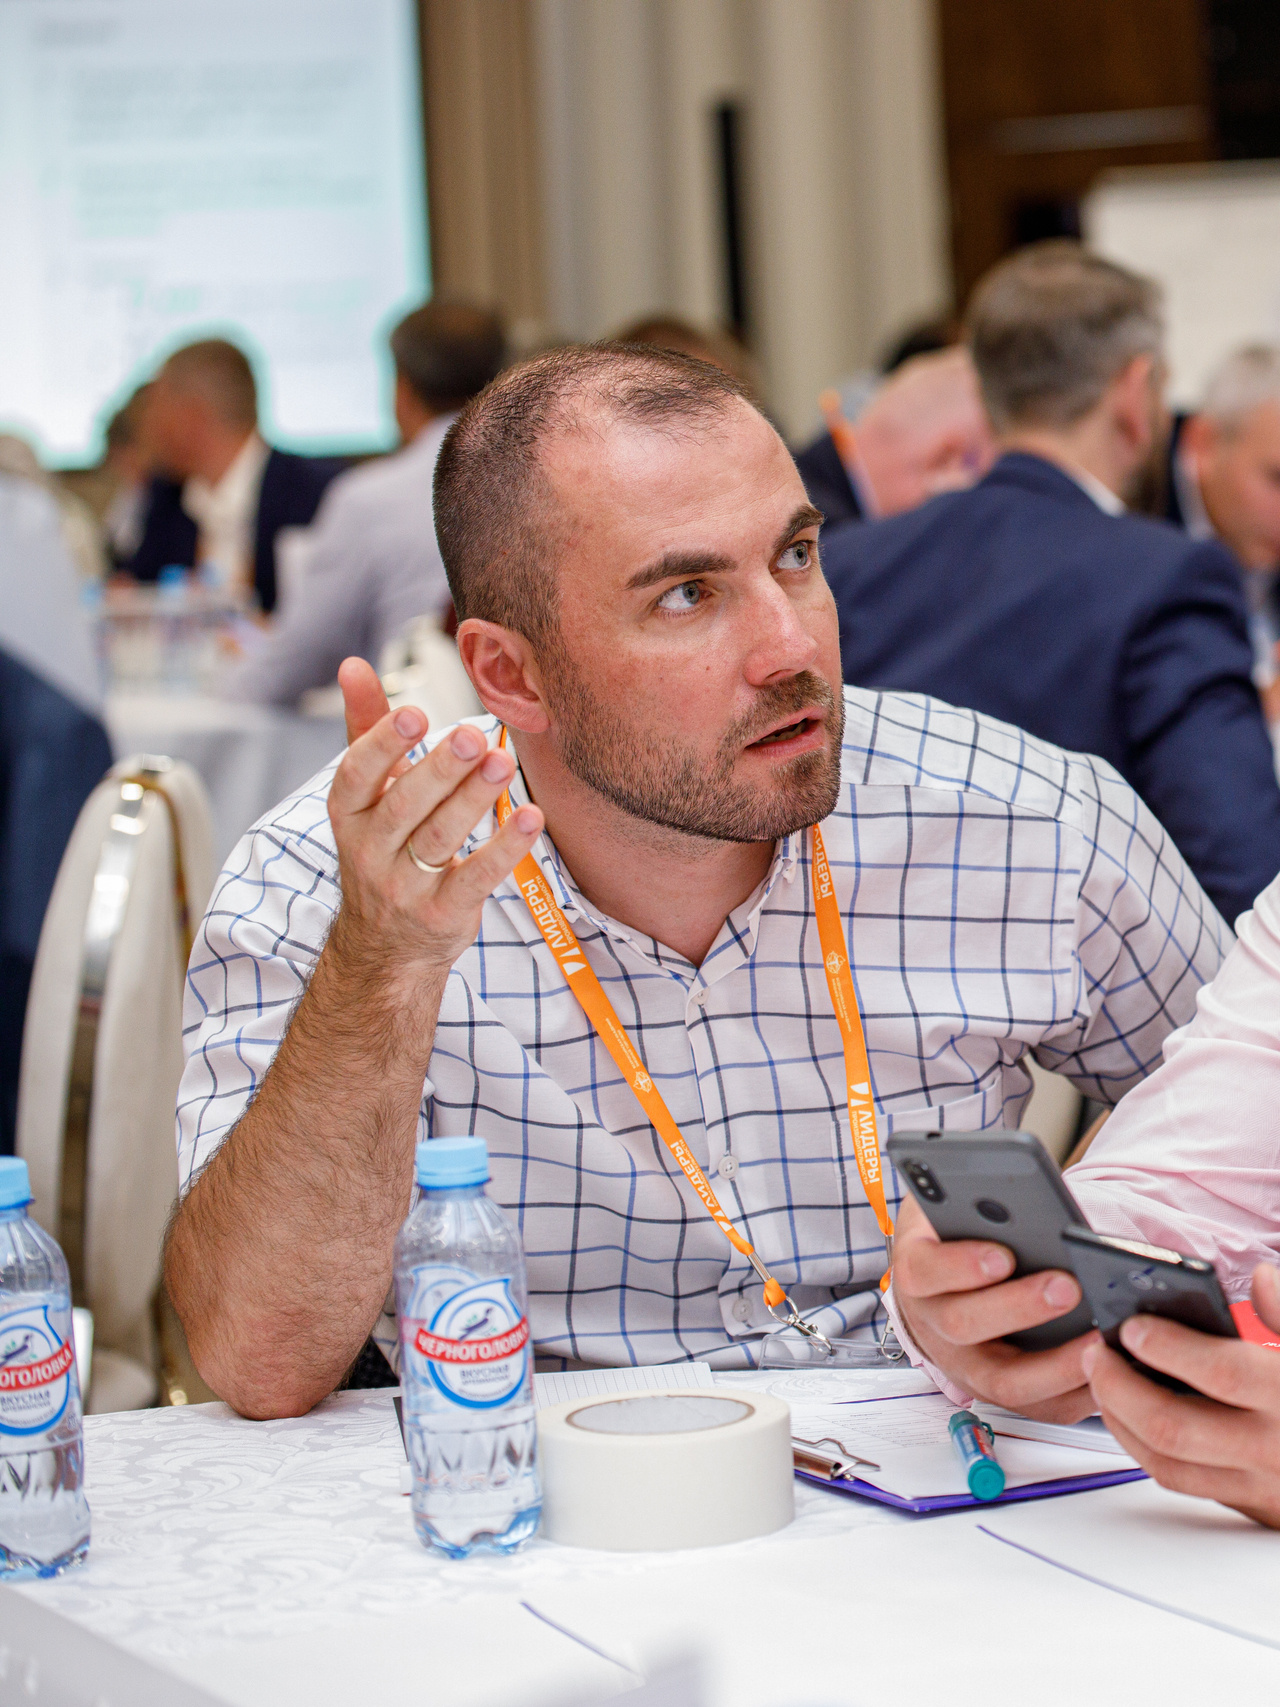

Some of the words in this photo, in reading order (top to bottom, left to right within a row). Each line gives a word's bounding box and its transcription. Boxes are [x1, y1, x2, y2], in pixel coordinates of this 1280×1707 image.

[813, 828, 834, 899] ЛИДЕРЫ
[521, 878, 568, 950] ЛИДЕРЫ
[535, 875, 575, 944] ПРОИЗВОДИТЕЛЬНОСТИ
[670, 1141, 715, 1208] ЛИДЕРЫ
[851, 1111, 869, 1186] ПРОИЗВОДИТЕЛЬНОСТИ
[858, 1110, 881, 1184] ЛИДЕРЫ
[418, 1324, 529, 1361] ЧЕРНОГОЛОВКА
